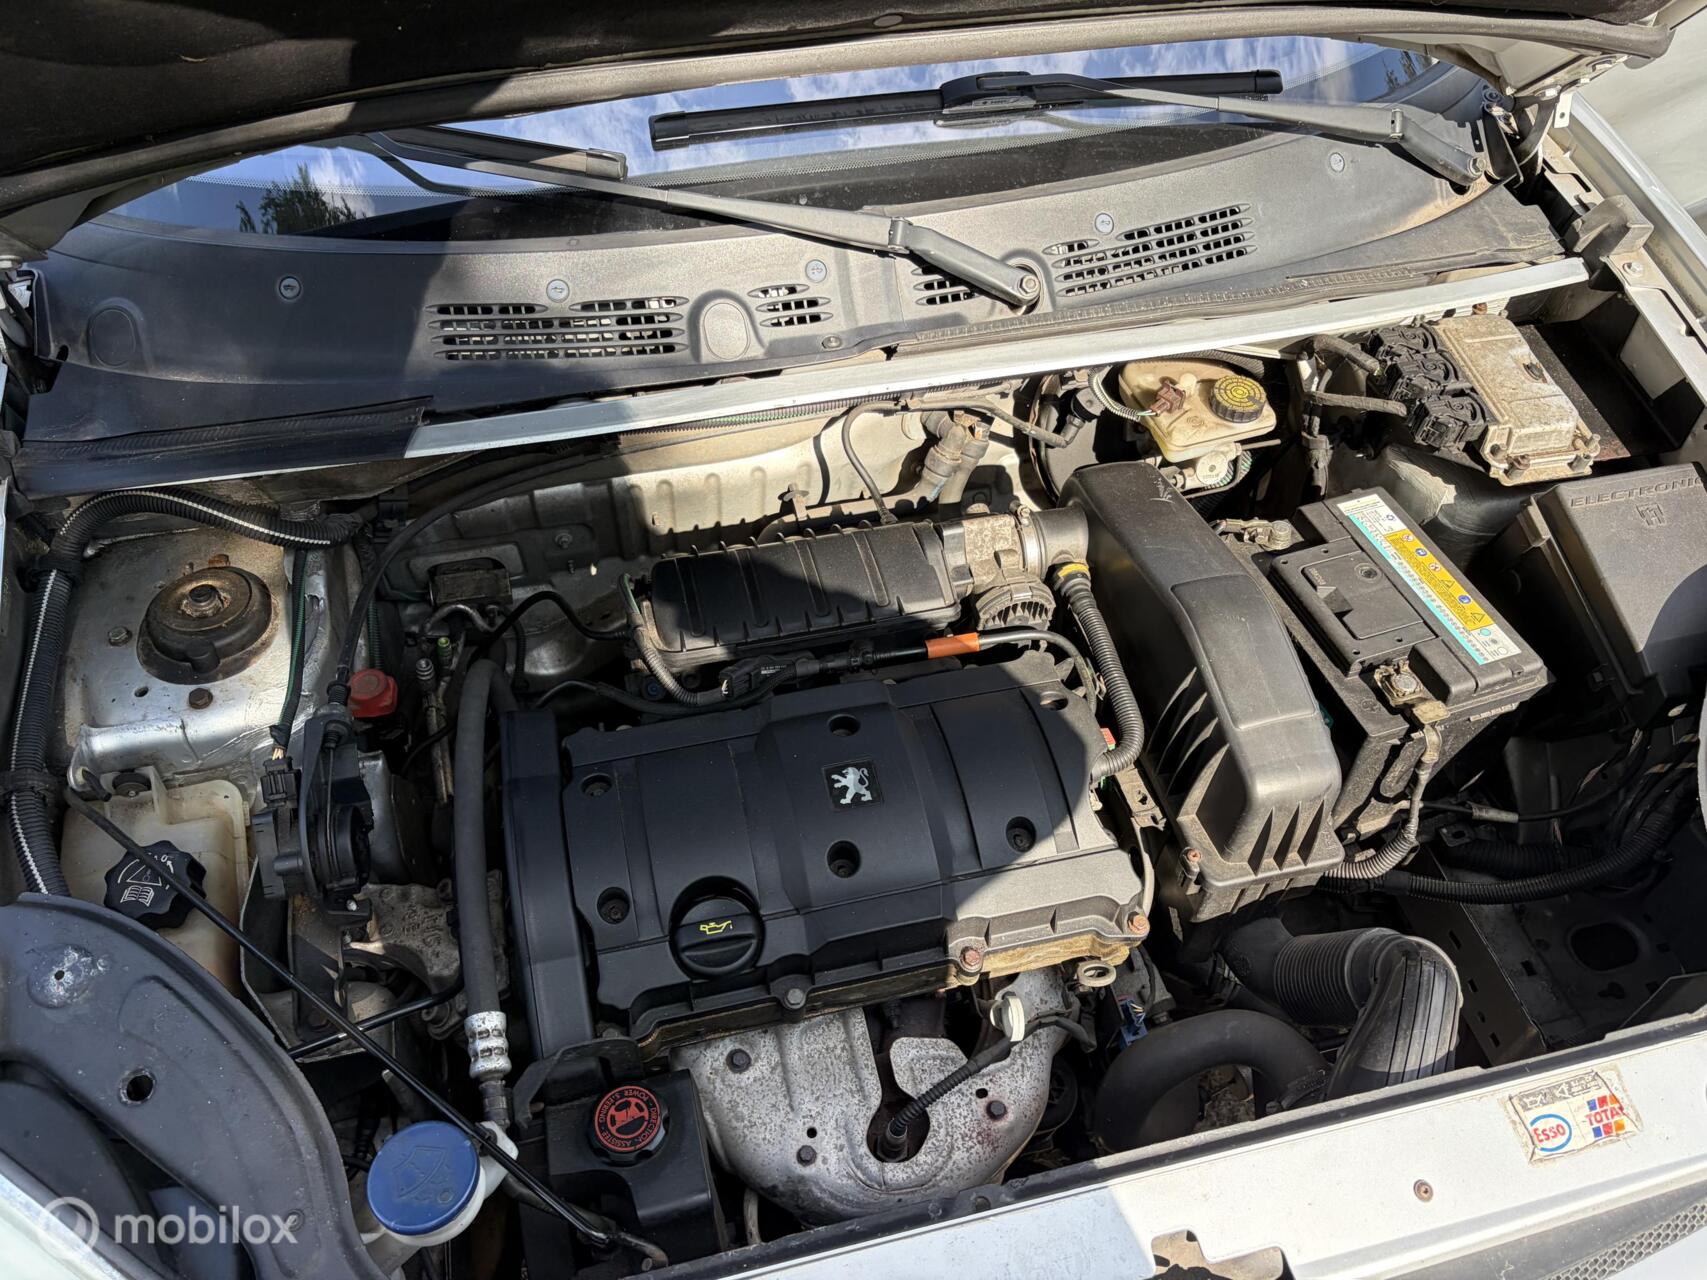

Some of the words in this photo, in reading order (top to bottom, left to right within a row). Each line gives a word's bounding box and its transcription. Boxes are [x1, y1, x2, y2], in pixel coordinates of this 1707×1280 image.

[624, 1089, 649, 1102] POWER
[598, 1093, 622, 1123] STEERING
[1533, 1123, 1566, 1144] ESSO
